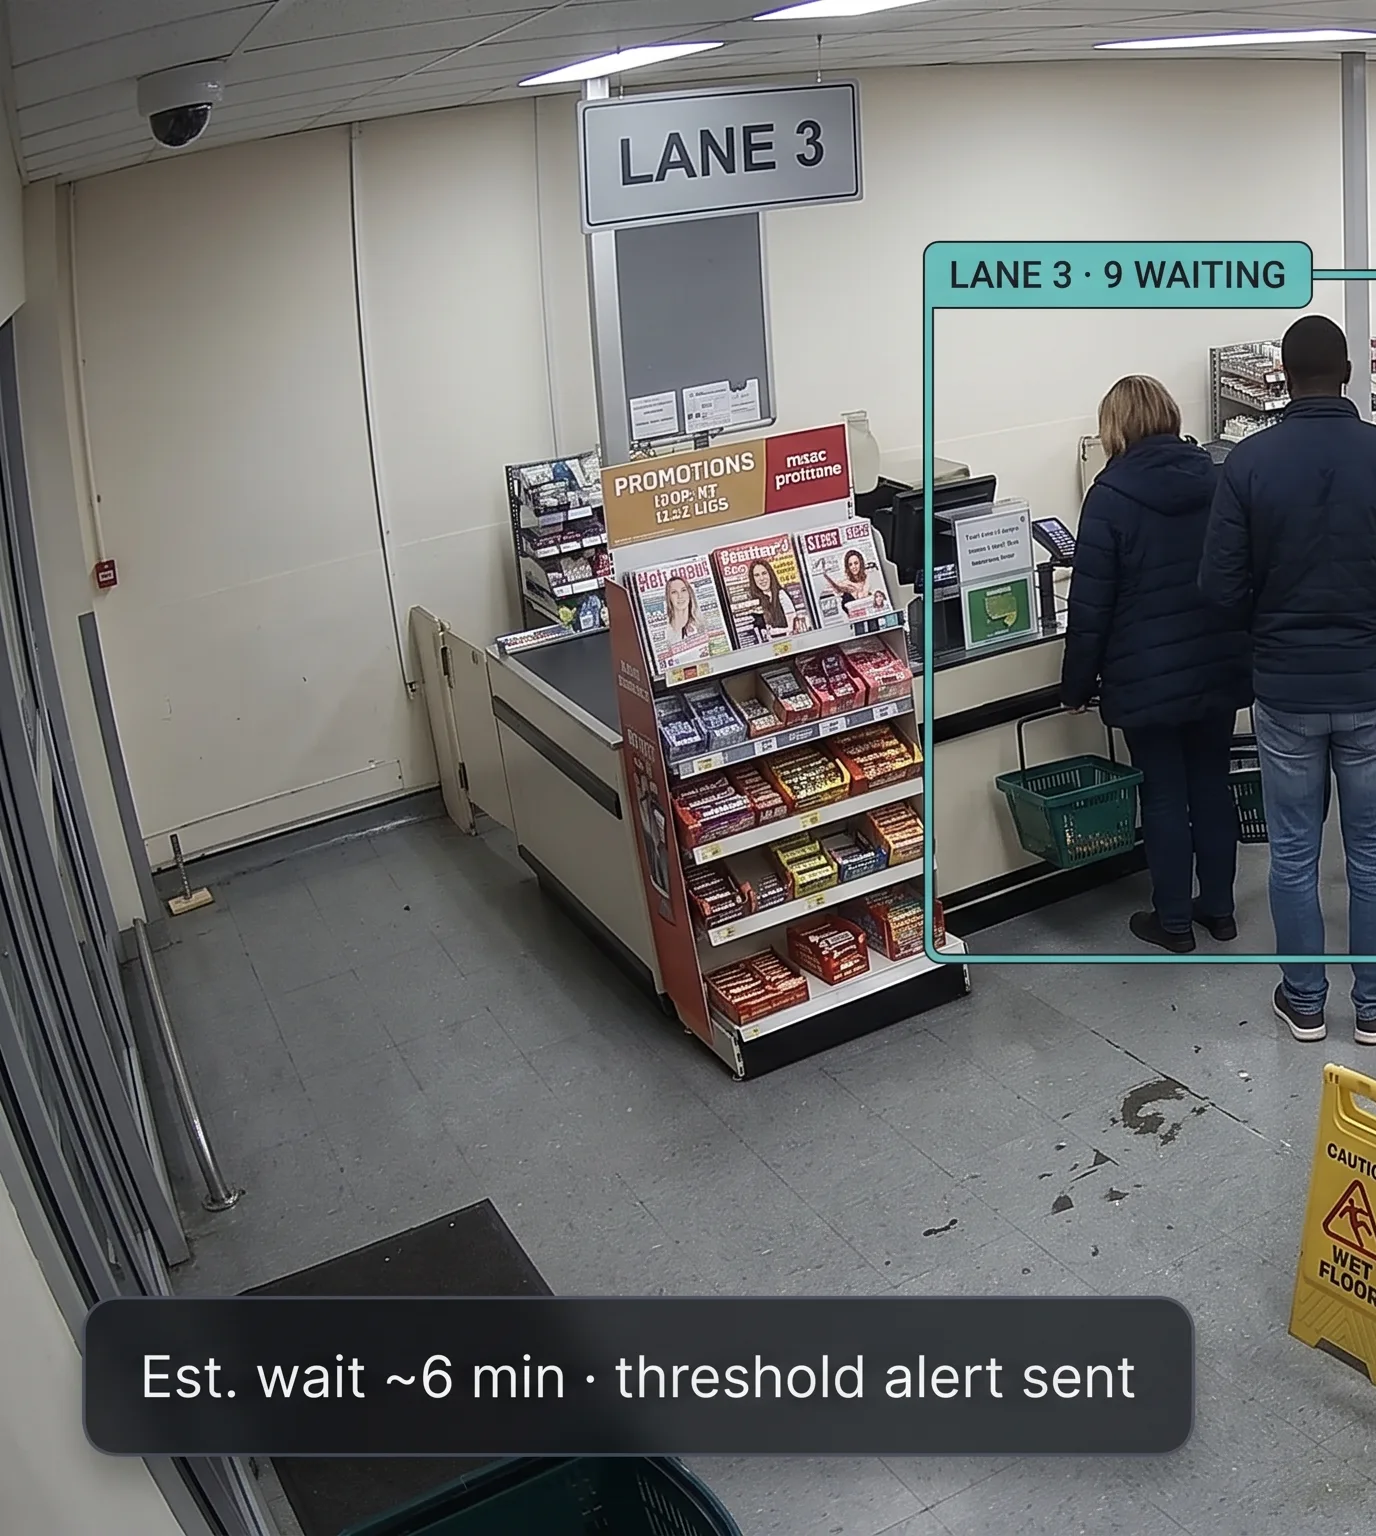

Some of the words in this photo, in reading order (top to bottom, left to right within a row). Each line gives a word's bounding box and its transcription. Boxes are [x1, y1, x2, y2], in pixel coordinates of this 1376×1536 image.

[621, 123, 776, 186] LANE
[796, 119, 824, 167] 3
[614, 451, 756, 497] PROMOTIONS
[1332, 1244, 1374, 1281] WET
